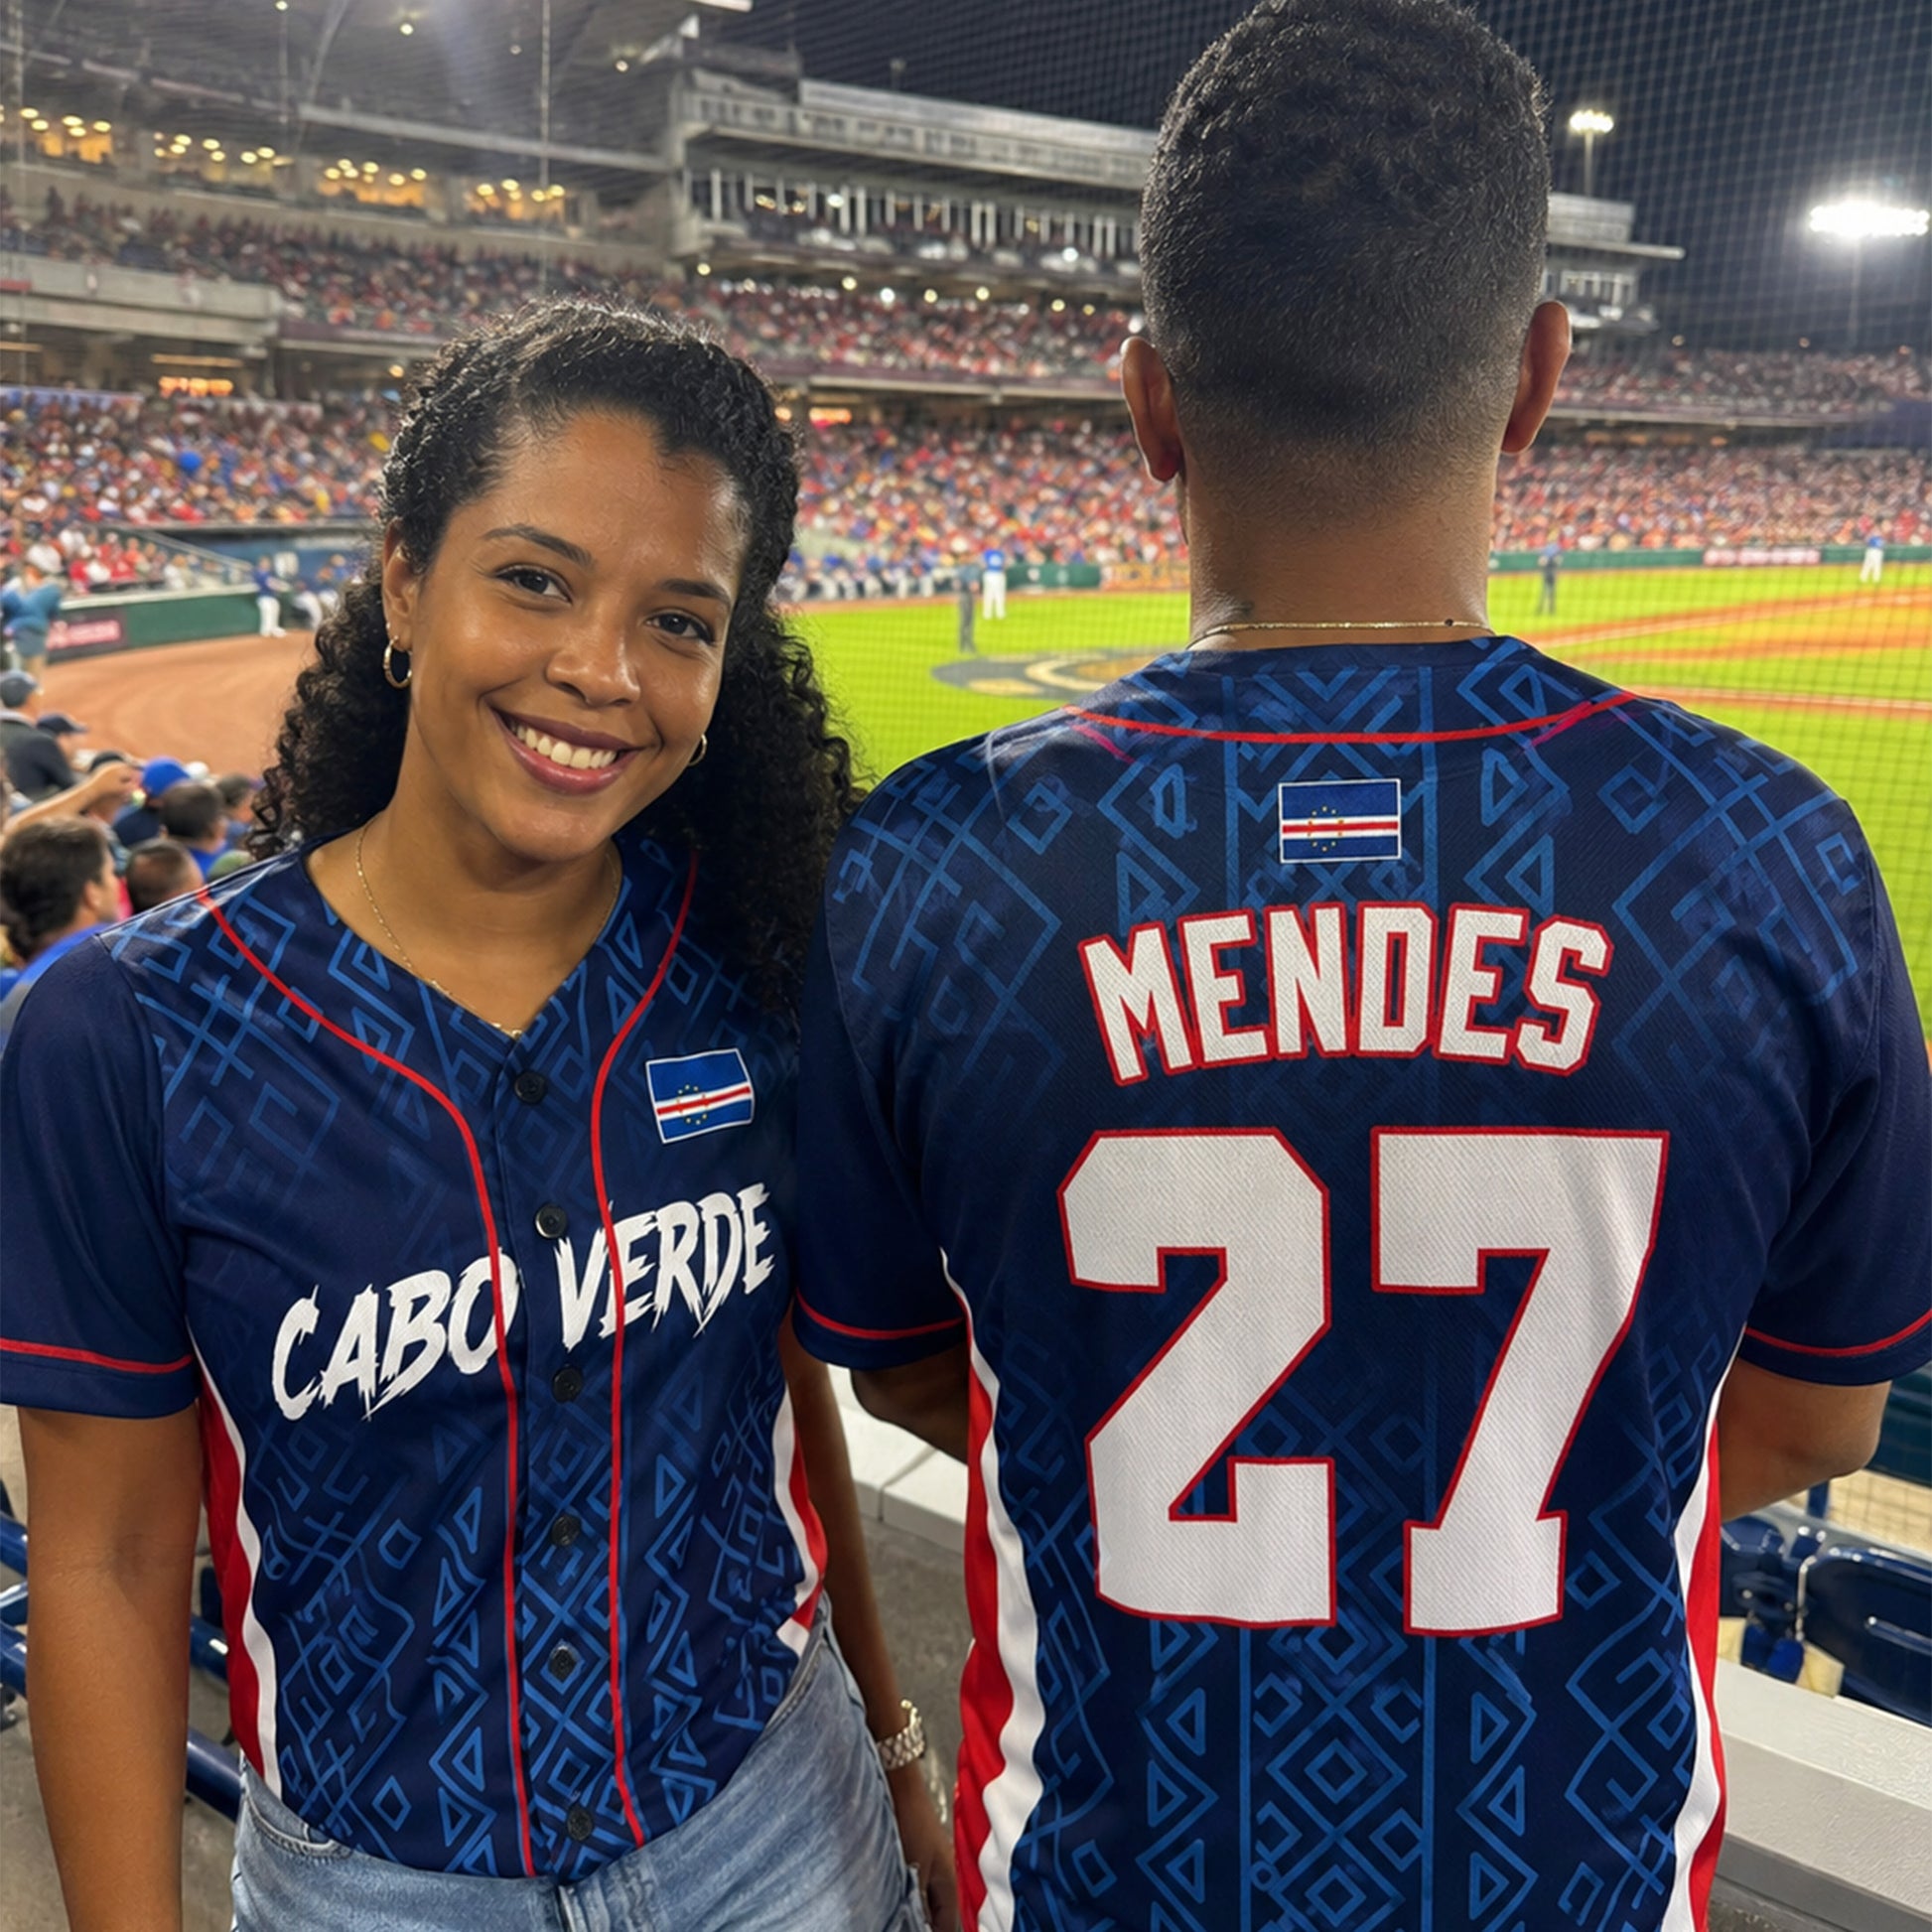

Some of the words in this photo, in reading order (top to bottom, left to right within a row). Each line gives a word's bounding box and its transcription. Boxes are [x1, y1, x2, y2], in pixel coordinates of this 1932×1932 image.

[1079, 901, 1613, 1086] MENDES
[272, 1247, 521, 1421] CABO
[555, 1183, 774, 1352] VERDE
[1057, 1127, 1669, 1637] 27
